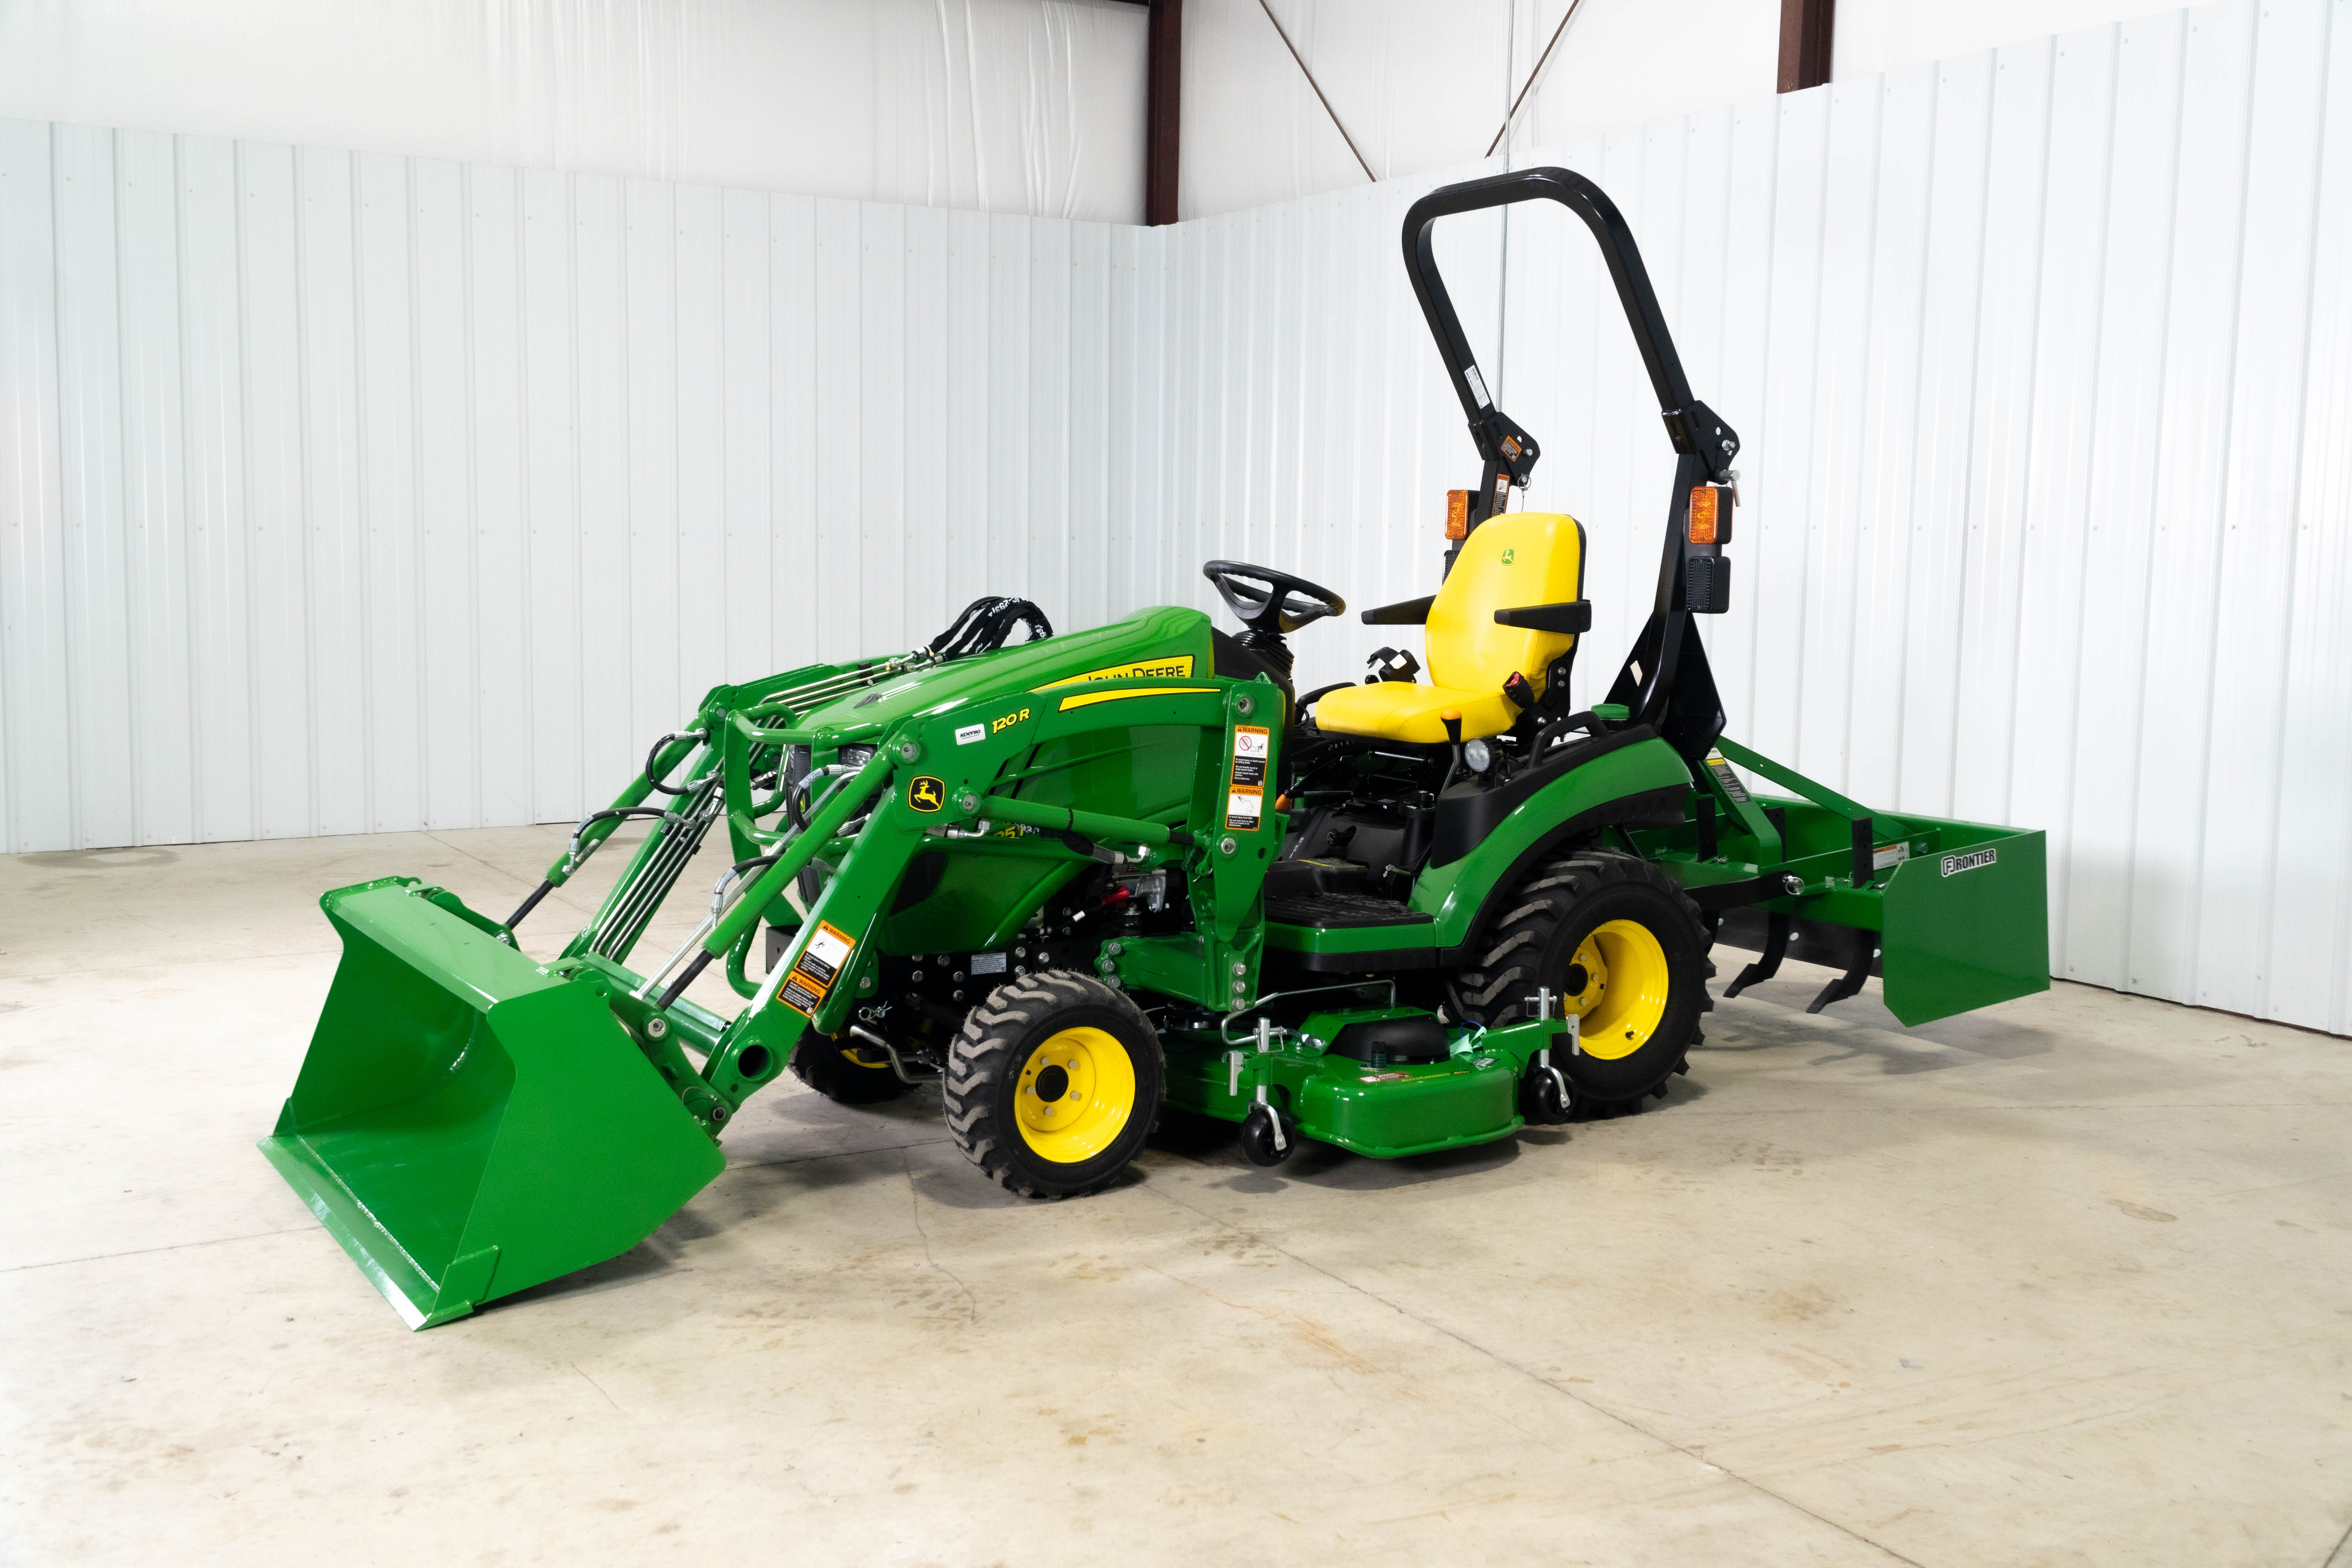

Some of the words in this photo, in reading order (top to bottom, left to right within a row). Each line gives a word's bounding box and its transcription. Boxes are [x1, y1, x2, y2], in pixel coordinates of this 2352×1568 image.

[992, 713, 1017, 734] 120
[1019, 708, 1030, 721] R
[1943, 849, 1996, 876] FRONTIER
[829, 928, 850, 944] WARNING
[799, 980, 821, 995] WARNING
